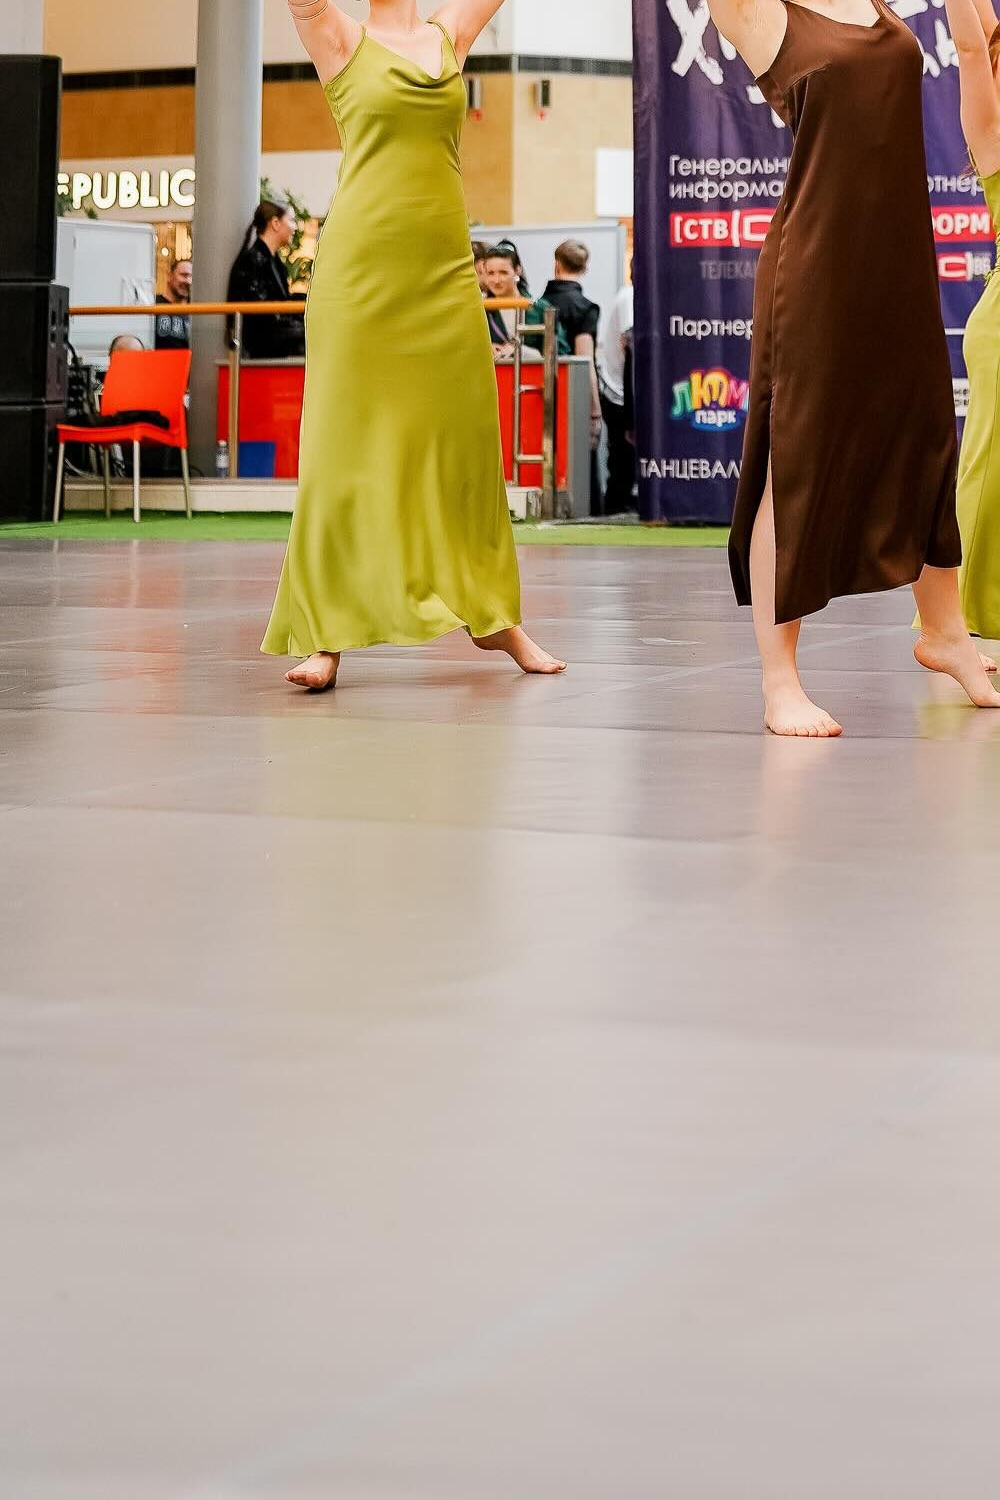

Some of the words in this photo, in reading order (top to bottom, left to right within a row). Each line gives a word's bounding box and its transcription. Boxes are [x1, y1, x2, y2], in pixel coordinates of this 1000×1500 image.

[669, 154, 792, 179] Генеральн
[931, 211, 990, 235] ОРМ
[694, 408, 737, 427] парк
[639, 458, 742, 481] ТАНЦЕВАЛ
